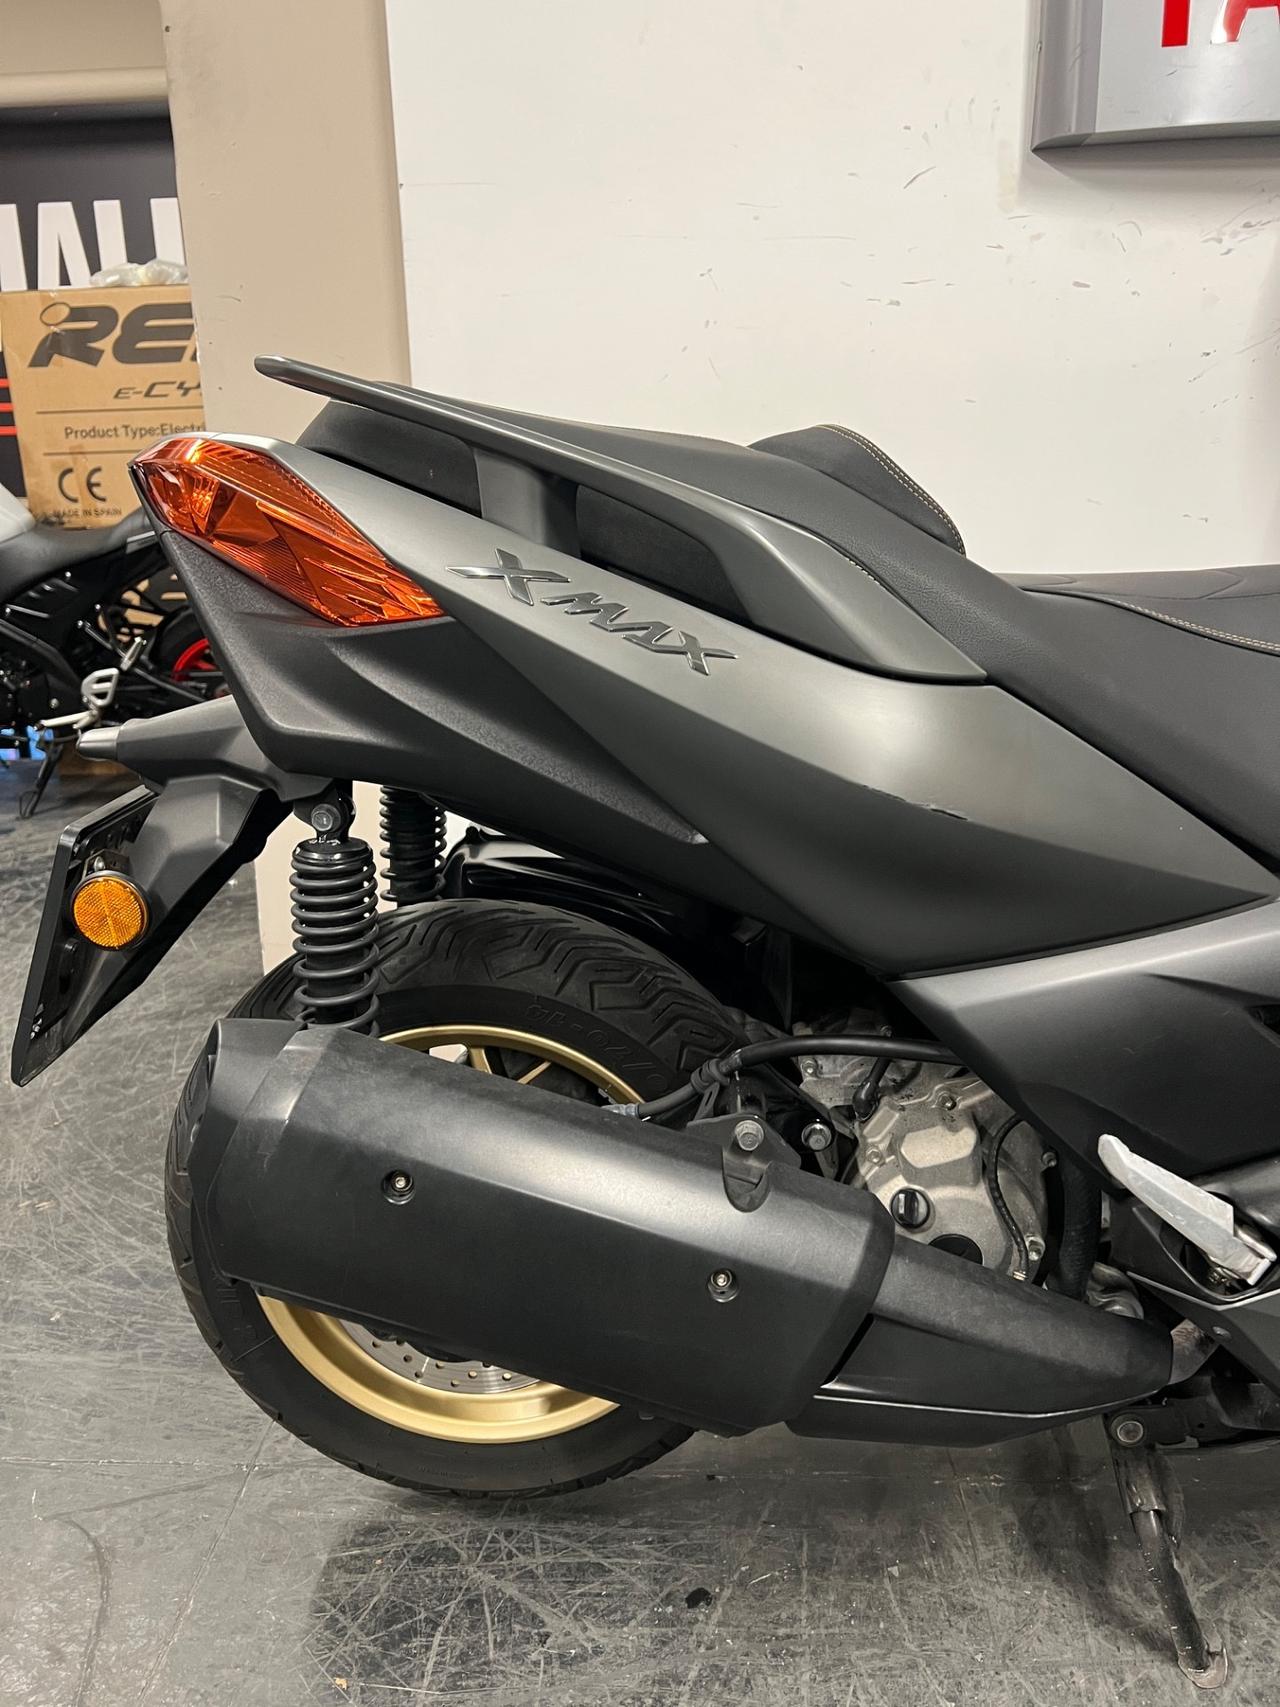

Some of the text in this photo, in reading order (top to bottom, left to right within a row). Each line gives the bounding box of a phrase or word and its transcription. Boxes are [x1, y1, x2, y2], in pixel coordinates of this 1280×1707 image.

[27, 302, 198, 367] RE
[113, 381, 202, 399] E-CY
[64, 425, 119, 439] Product
[58, 466, 107, 504] CE
